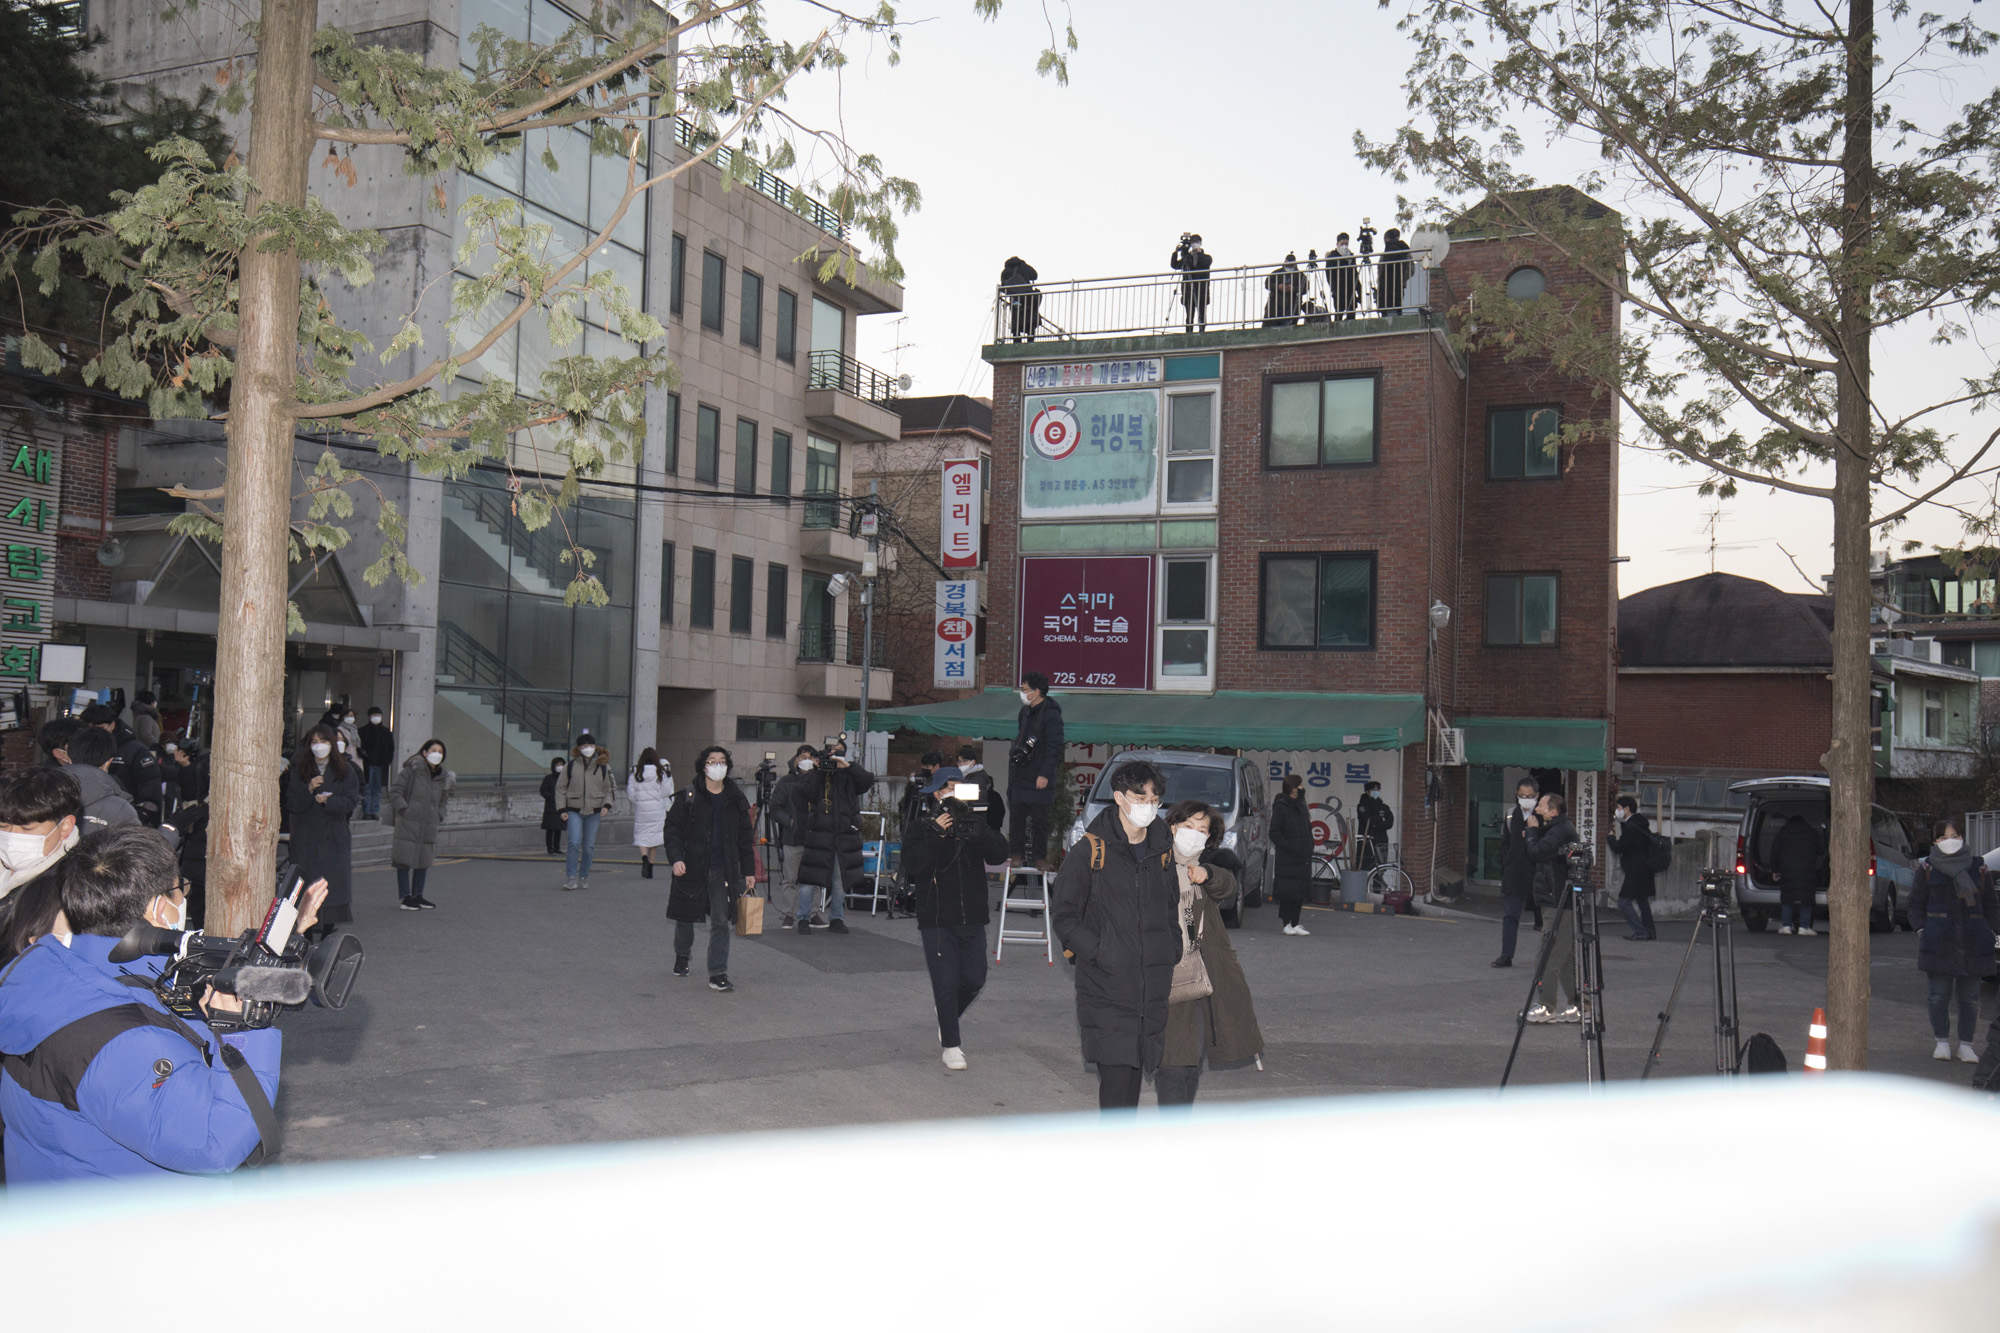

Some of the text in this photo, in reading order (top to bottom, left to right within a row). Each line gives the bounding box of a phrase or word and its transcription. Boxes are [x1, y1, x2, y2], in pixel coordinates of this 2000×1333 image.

[1027, 366, 1058, 388] 신용과
[1062, 363, 1093, 386] 품질을
[1136, 360, 1157, 382] 하는
[1090, 413, 1143, 453] 학생복
[952, 473, 971, 552] 엘리트
[0, 445, 54, 685] 새사람교회
[1060, 593, 1115, 610] 스키마
[1044, 615, 1128, 633] 국어 논술
[1084, 635, 1104, 643] Since
[1106, 635, 1128, 643] 2006
